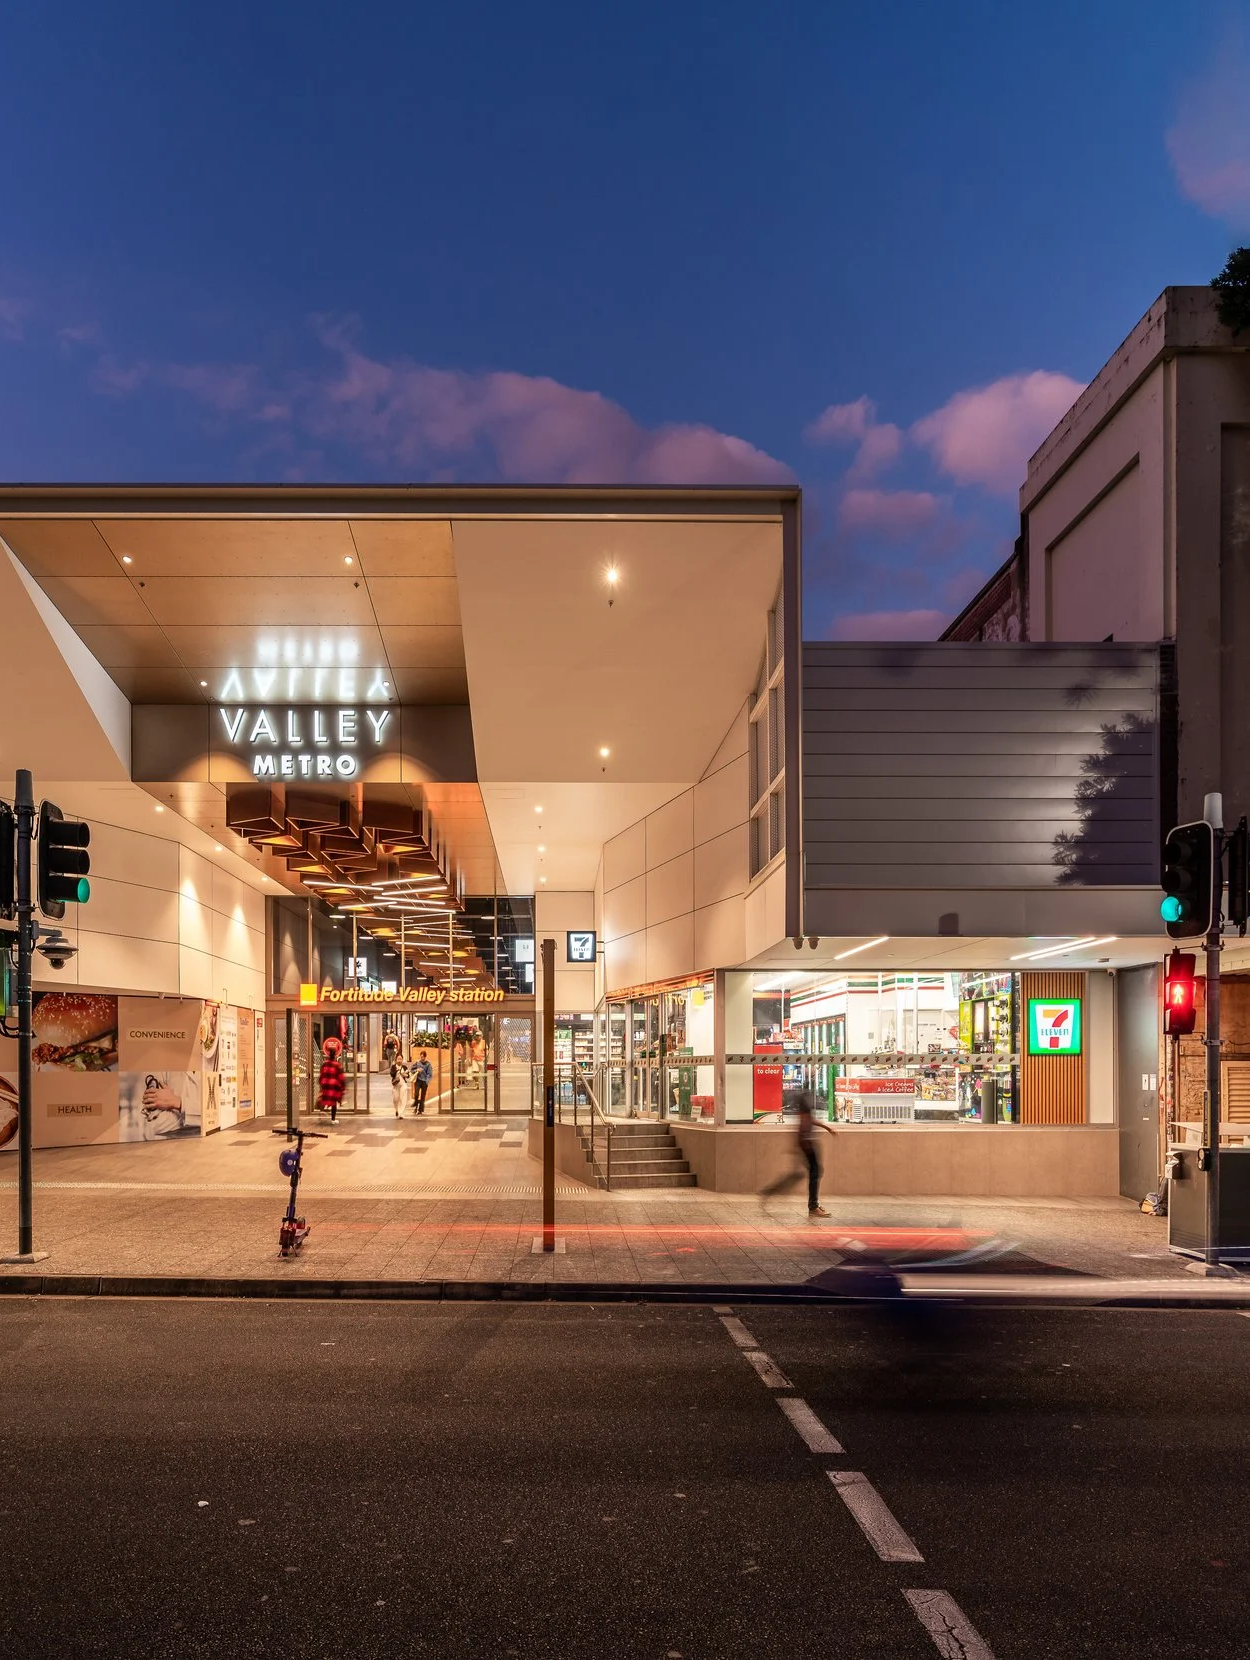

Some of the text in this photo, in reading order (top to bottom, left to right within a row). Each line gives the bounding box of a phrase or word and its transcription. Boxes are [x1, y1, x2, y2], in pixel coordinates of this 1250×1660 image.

[219, 708, 391, 744] VALLEY
[253, 755, 357, 777] METRO
[320, 986, 505, 1005] Fortitude Valley station
[129, 1030, 186, 1040] CONVENIENCE
[1043, 1009, 1069, 1049] 7
[57, 1105, 92, 1115] HEALTH
